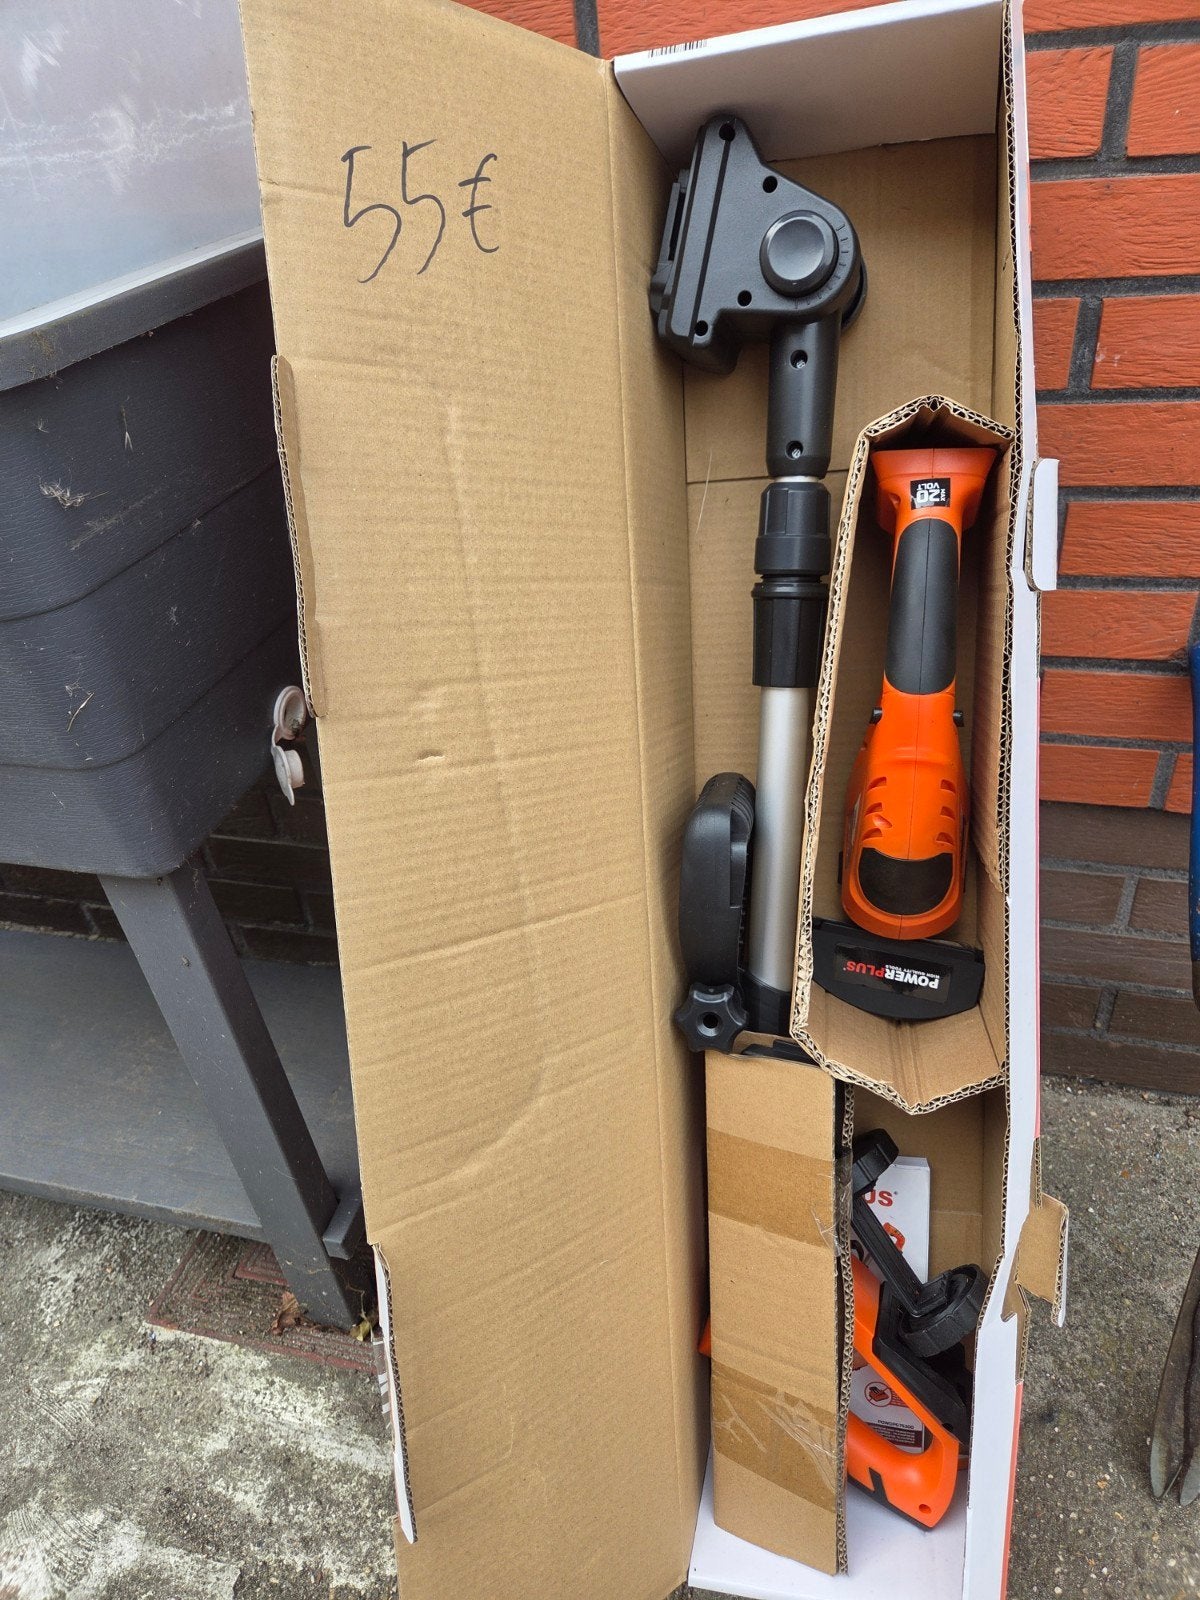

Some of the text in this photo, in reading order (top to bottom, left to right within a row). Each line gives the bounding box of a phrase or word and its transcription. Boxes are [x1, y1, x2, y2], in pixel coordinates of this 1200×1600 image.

[341, 138, 500, 284] 55€
[916, 482, 940, 491] VOLT
[916, 489, 940, 503] 20
[845, 960, 941, 990] POWERPLUS
[885, 964, 903, 972] TOOLS
